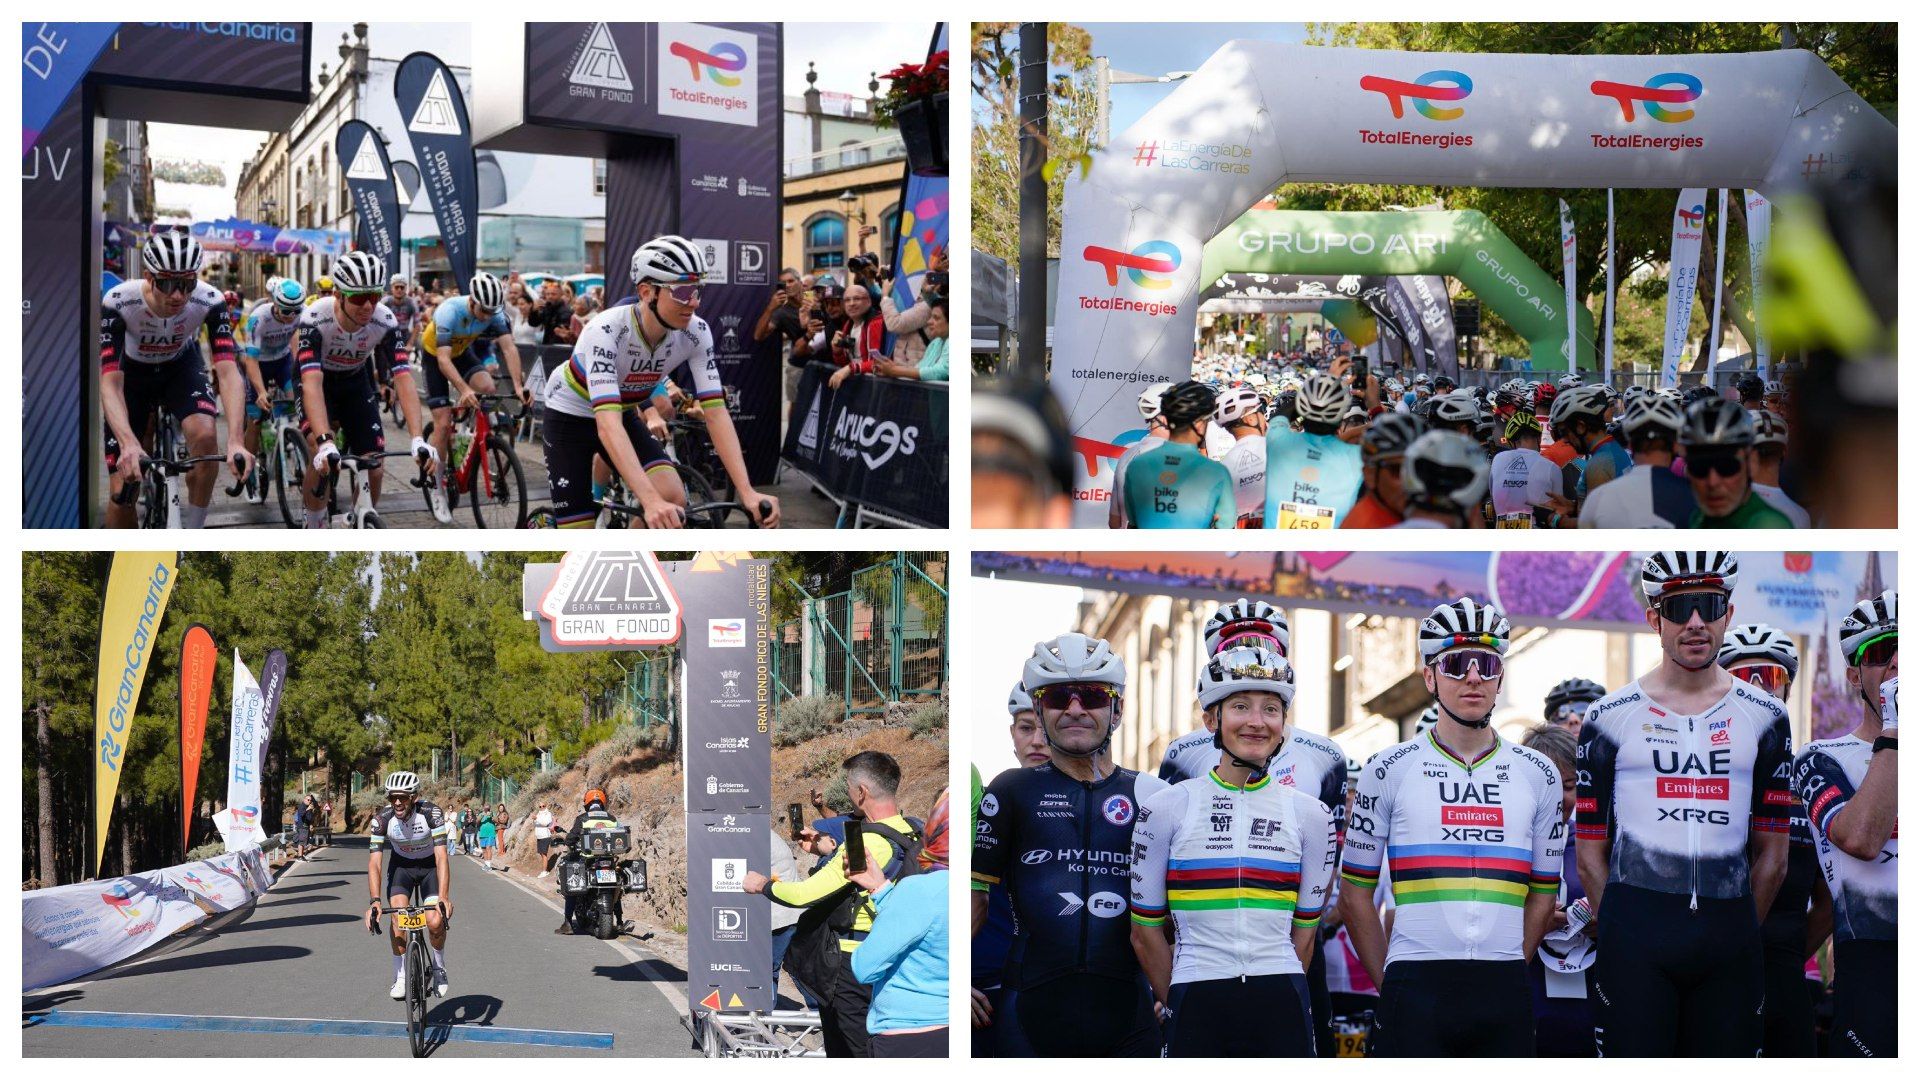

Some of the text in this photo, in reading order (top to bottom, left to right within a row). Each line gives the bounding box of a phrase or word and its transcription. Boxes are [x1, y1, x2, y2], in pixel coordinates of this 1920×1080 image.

[569, 85, 633, 104] GRAN FONDO
[670, 88, 747, 110] TotalEnergies
[1359, 130, 1473, 149] TotalEnergies
[1590, 134, 1704, 152] TotalEnergies
[1161, 155, 1250, 175] LasCarreras
[1238, 230, 1375, 255] GRUPO
[1475, 249, 1529, 298] GRUPO
[1079, 296, 1177, 316] TotalEnergies
[630, 359, 666, 373] UAE
[1072, 368, 1170, 383] totalenergies.es
[1154, 487, 1179, 498] bike
[1293, 482, 1320, 493] bike
[1154, 498, 1178, 514] bé
[747, 564, 755, 607] modalidad
[572, 602, 661, 612] GRAN CANARIA
[562, 618, 670, 634] GRAN FONDO
[109, 561, 170, 733] GranCanaria
[756, 564, 768, 733] GRAN FONDO PICO DE LAS NIEVES
[187, 643, 200, 739] GranCanaria
[1599, 692, 1641, 712] Analog
[1744, 694, 1782, 717] Analog
[242, 692, 260, 763] LasCarreras
[1303, 738, 1342, 762] Analog
[1383, 743, 1420, 768] Analog
[1522, 750, 1556, 786] Analog
[1653, 748, 1731, 775] UAE
[1428, 770, 1448, 778] UCI
[1439, 782, 1502, 804] UAE
[1664, 781, 1724, 794] Emirates
[982, 799, 996, 811] Fer
[1447, 810, 1498, 822] Emirates
[1657, 807, 1730, 826] XRG
[1213, 823, 1230, 832] LY!
[1250, 818, 1282, 837] EF
[1441, 827, 1504, 842] XRG
[1248, 835, 1272, 843] Education
[1248, 843, 1286, 853] cannondale
[1094, 899, 1121, 910] Fer
[403, 917, 422, 927] 240
[714, 963, 731, 972] UCI
